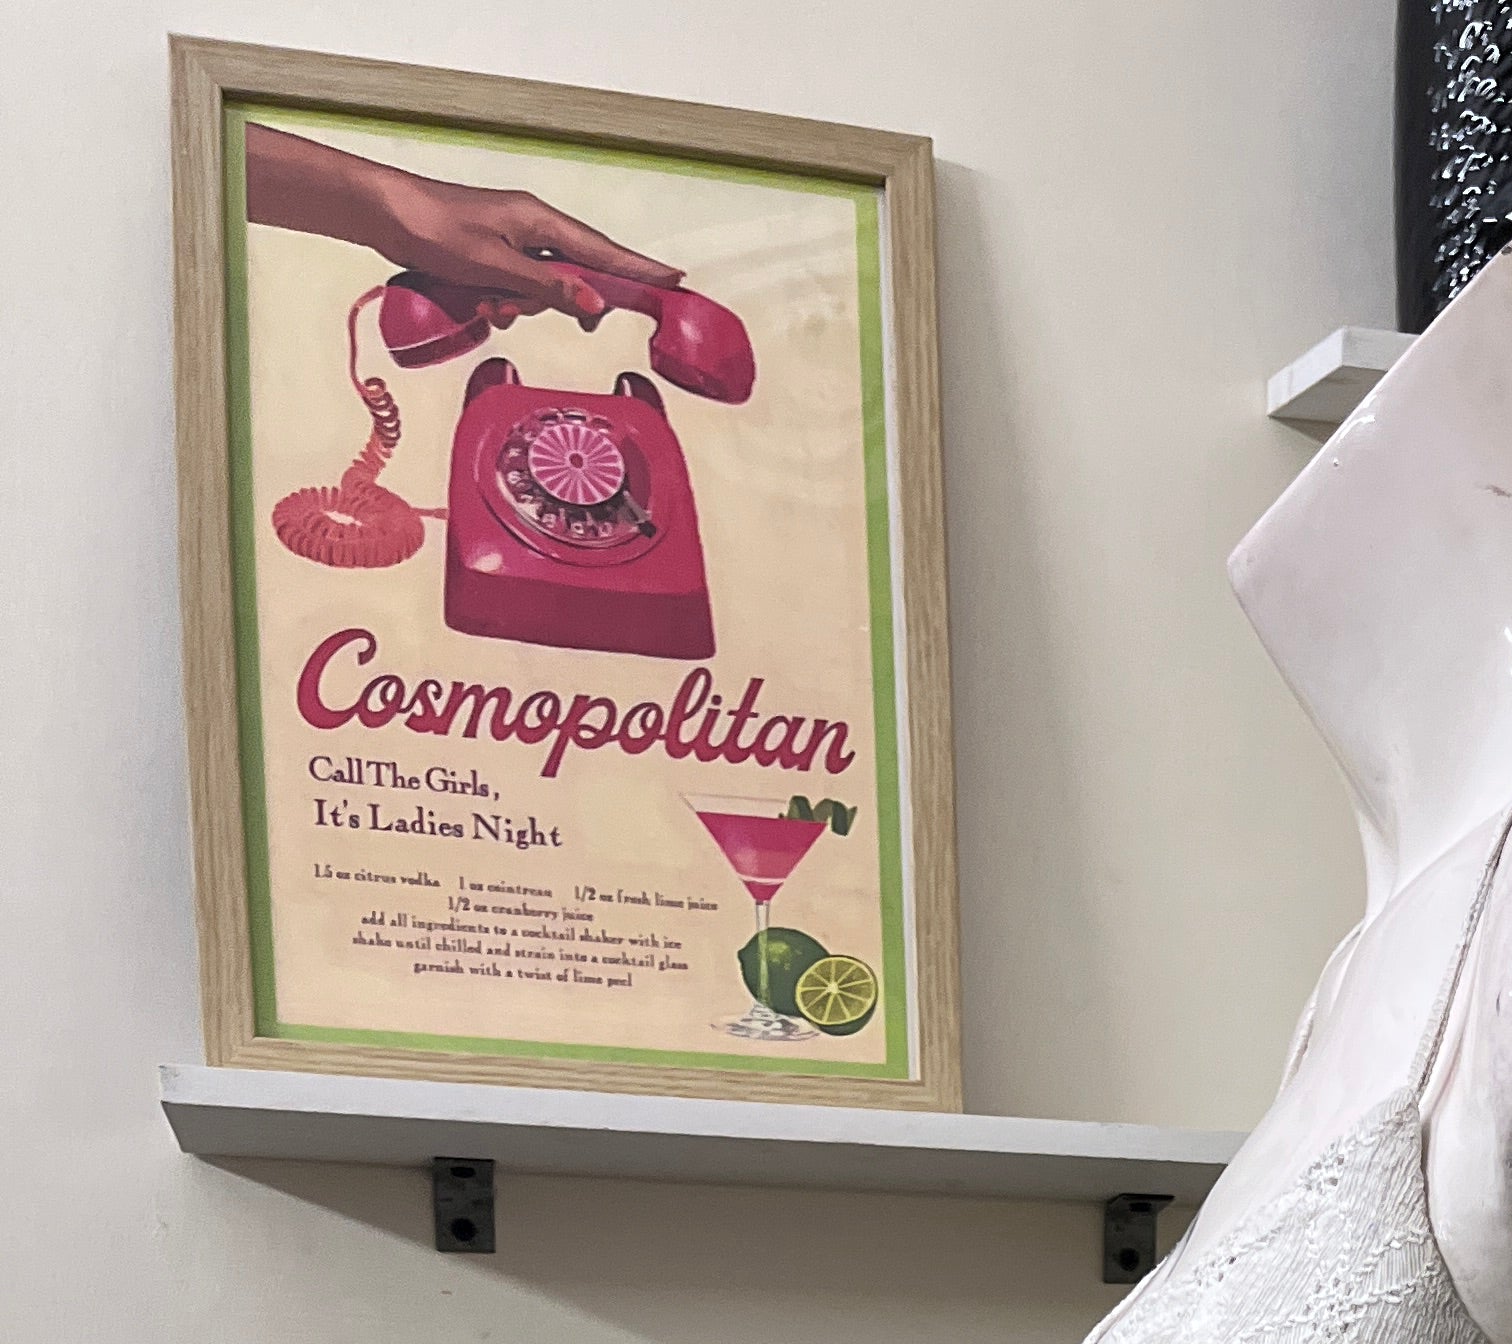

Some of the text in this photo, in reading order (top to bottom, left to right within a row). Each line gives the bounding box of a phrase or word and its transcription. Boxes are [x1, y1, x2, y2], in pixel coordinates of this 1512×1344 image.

[297, 628, 855, 777] Cosmopolitan
[309, 756, 499, 801] Call The Girls,
[314, 798, 563, 849] It's Ladies Night
[354, 869, 396, 884] citrus
[400, 871, 441, 887] vodka
[487, 881, 552, 897] cointreau
[575, 885, 596, 902] 1/2
[655, 891, 684, 909] lime
[688, 896, 718, 910] juice
[448, 896, 470, 912] 1/2
[491, 903, 558, 920] cranberry
[562, 907, 594, 921] juice
[352, 930, 391, 947] shake
[396, 936, 431, 950] until
[435, 936, 481, 955] chilled
[487, 943, 510, 957] and
[515, 947, 555, 960] strain
[559, 949, 587, 962] into
[602, 951, 654, 968] cocktail
[361, 910, 385, 926] add
[390, 912, 407, 927] all
[412, 915, 490, 934] ingredients
[494, 925, 507, 936] to
[521, 925, 575, 941] cocktail
[579, 927, 624, 945] shaker
[628, 933, 659, 948] with
[664, 936, 682, 949] ice
[414, 959, 463, 974] garnish
[469, 962, 501, 977] with
[518, 968, 551, 980] twist
[556, 968, 570, 982] of
[573, 968, 603, 985] lime
[607, 972, 632, 987] peel
